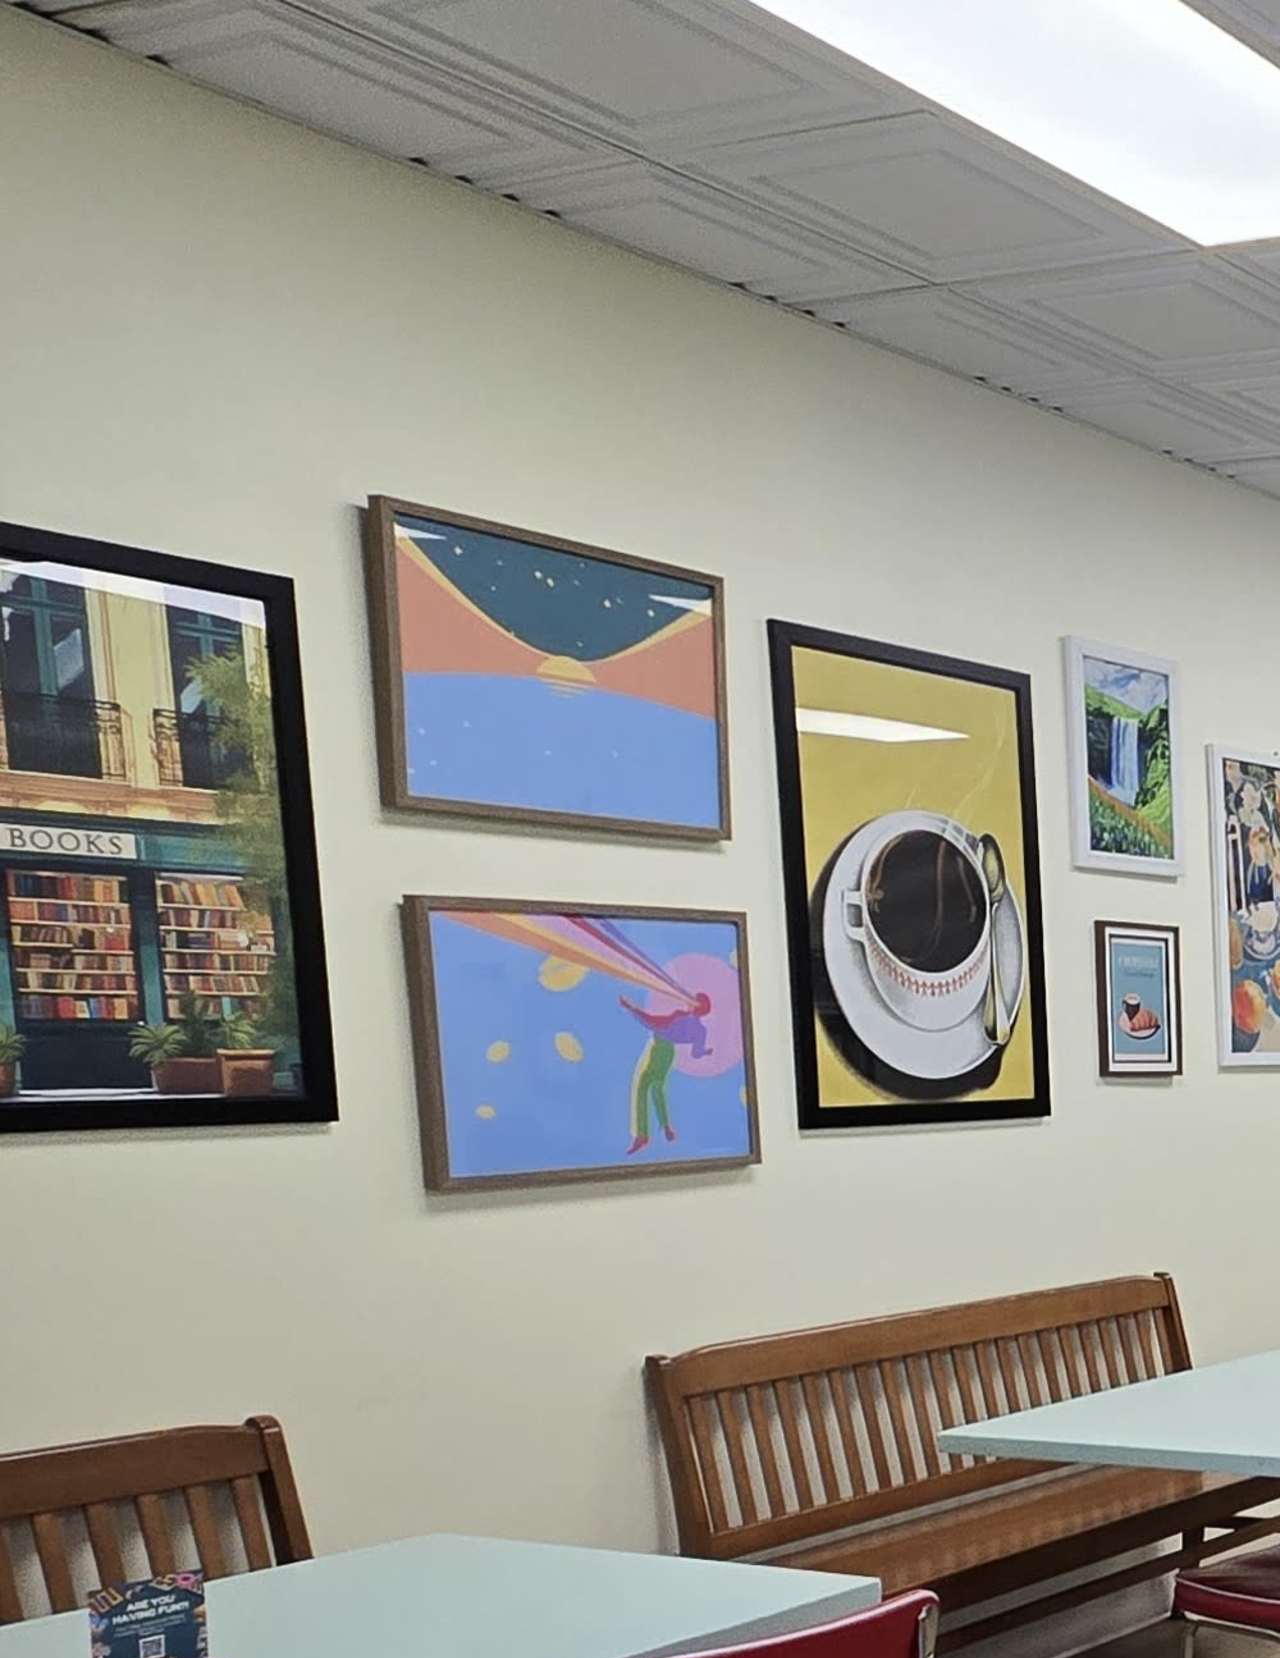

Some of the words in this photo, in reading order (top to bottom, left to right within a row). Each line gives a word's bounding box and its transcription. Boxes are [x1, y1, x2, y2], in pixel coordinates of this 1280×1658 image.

[6, 828, 122, 855] BOOKS
[126, 1599, 149, 1612] ARE
[150, 1594, 176, 1606] YOU
[112, 1609, 156, 1625] HAVING
